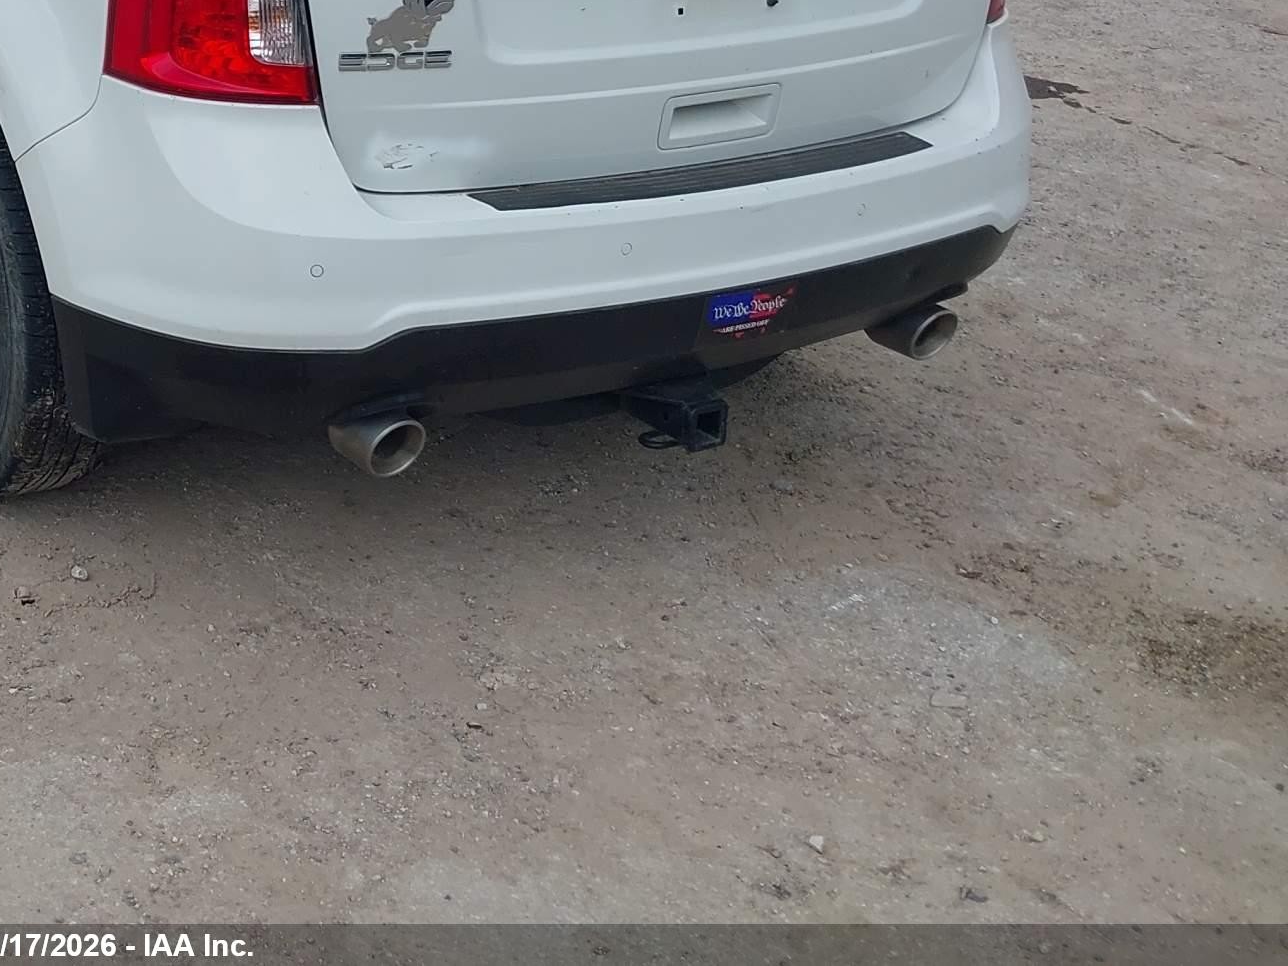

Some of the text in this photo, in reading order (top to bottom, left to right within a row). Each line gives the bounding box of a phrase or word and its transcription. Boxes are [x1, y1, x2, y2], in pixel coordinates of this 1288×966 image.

[338, 50, 453, 71] EDGE
[713, 305, 733, 320] We
[749, 294, 788, 313] People
